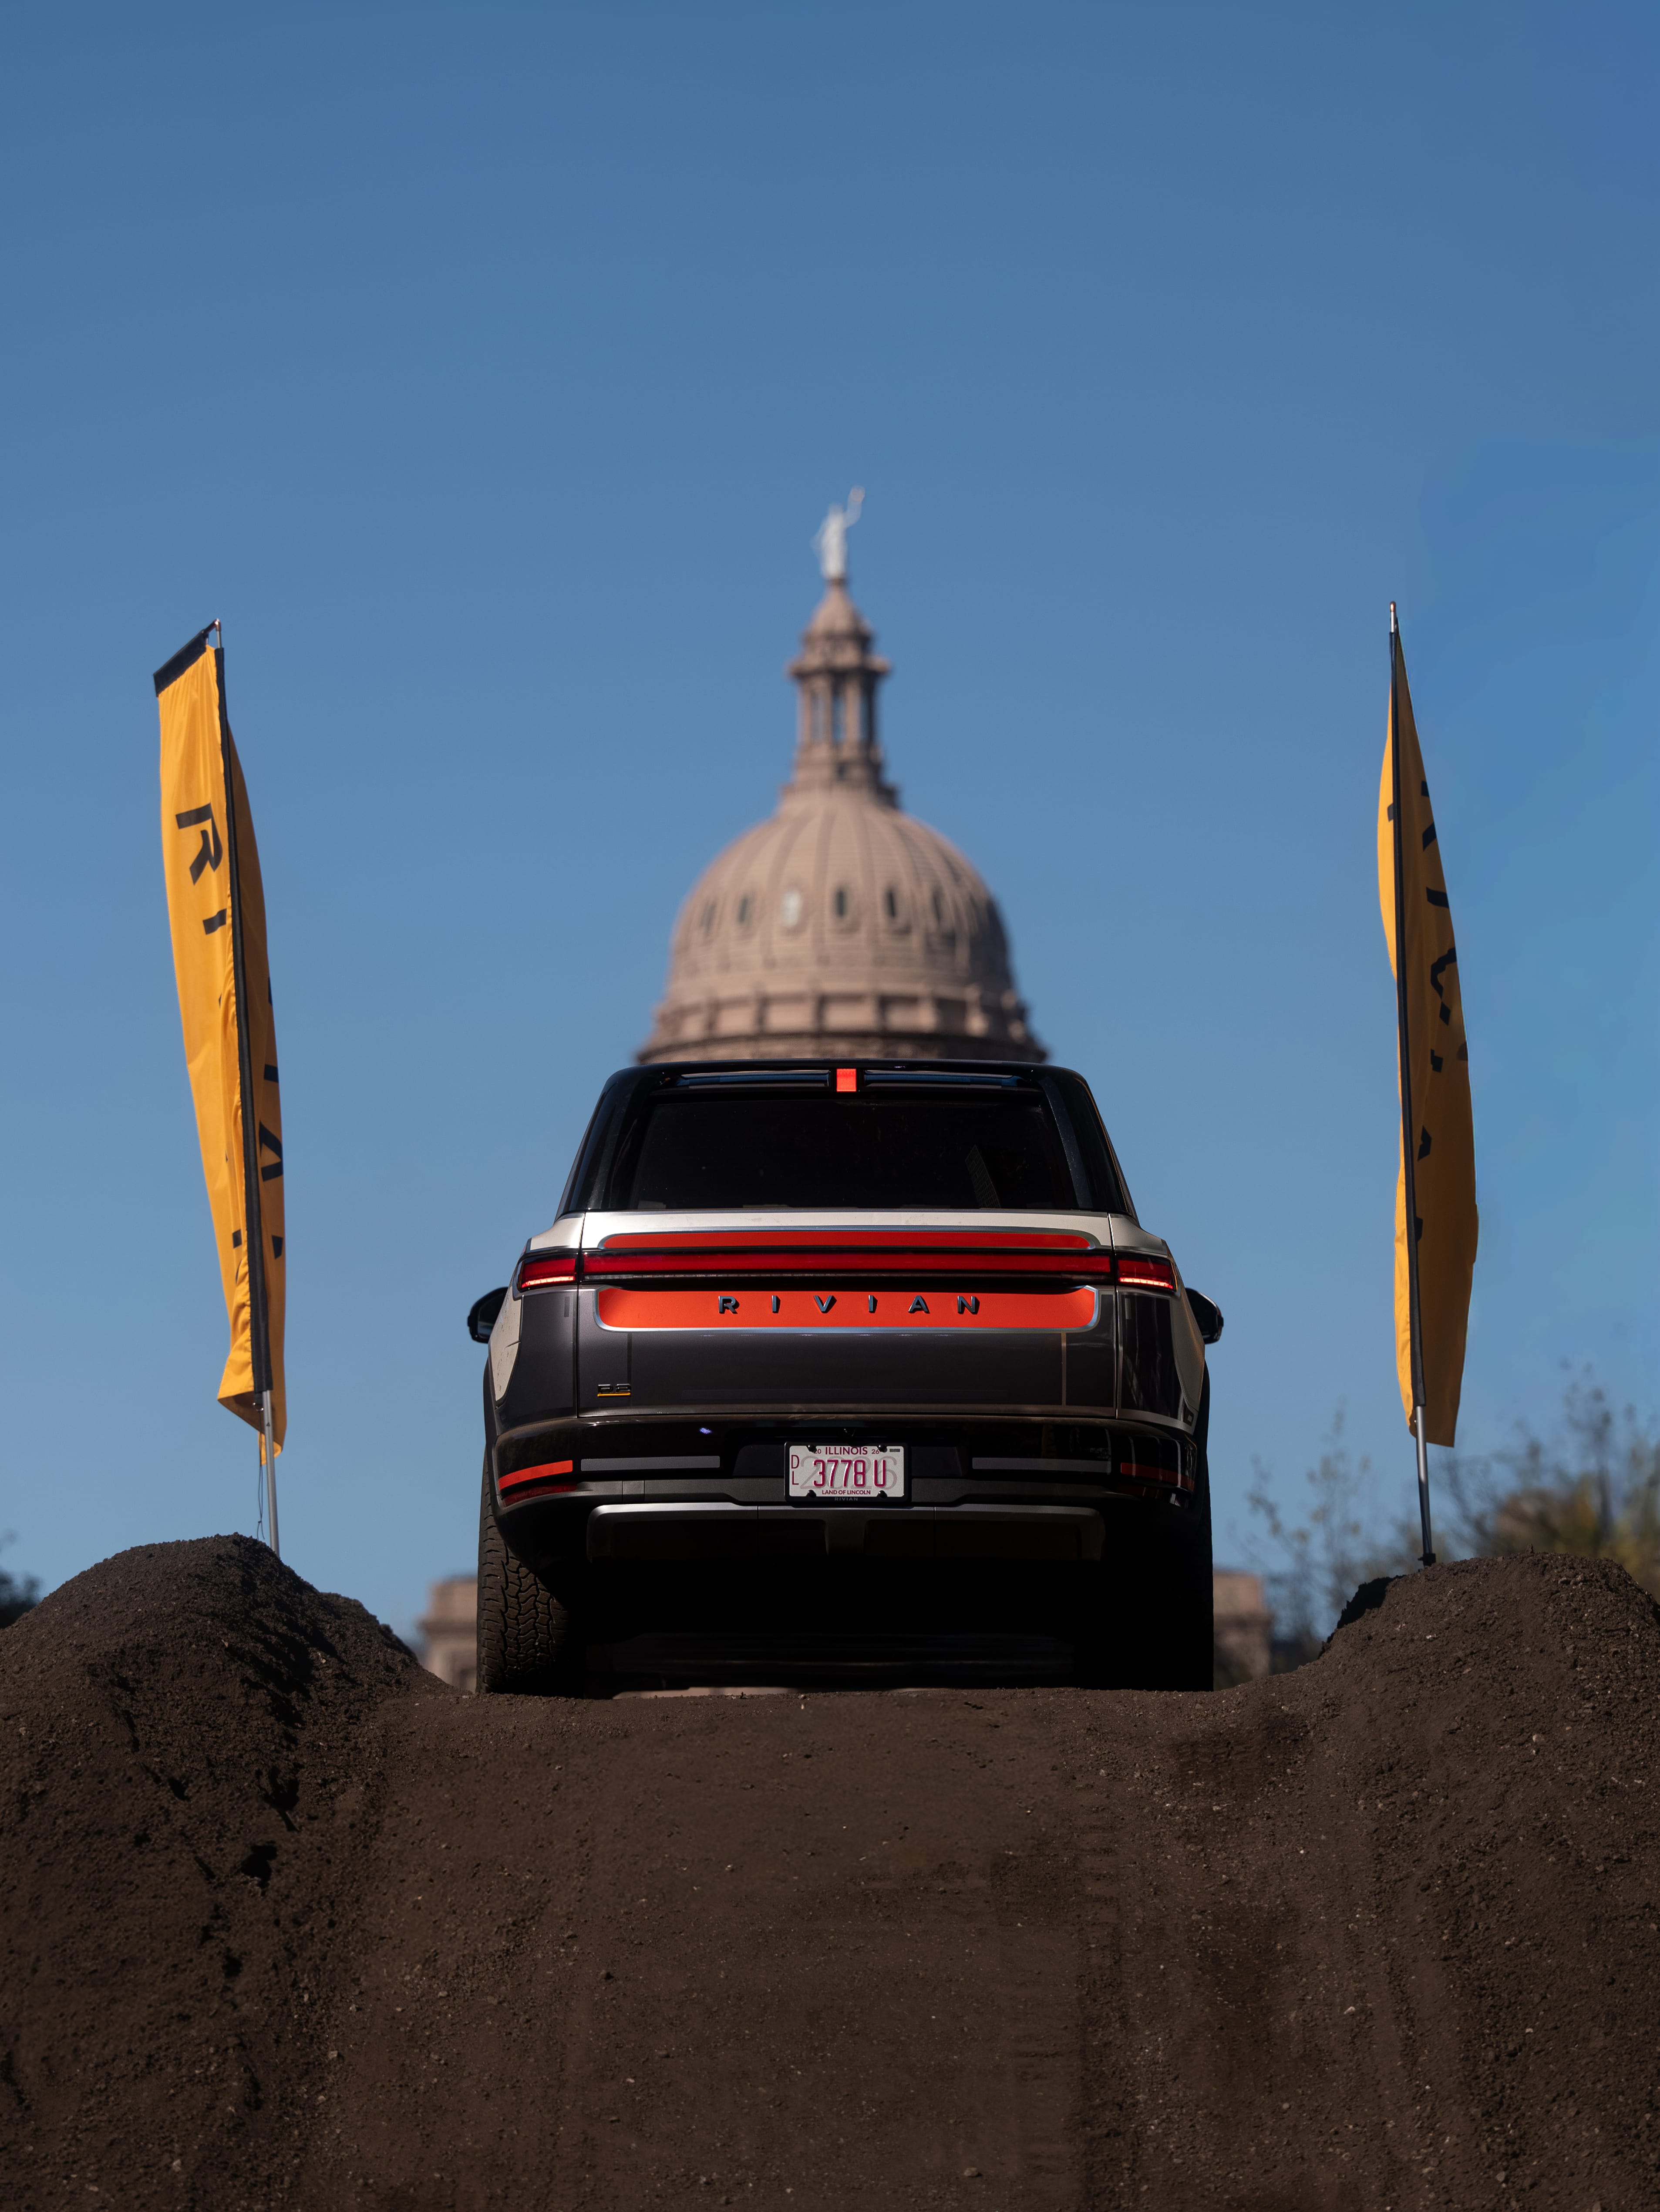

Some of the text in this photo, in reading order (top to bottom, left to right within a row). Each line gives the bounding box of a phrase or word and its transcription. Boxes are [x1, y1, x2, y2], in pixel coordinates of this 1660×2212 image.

[718, 1294, 979, 1314] RIVIAN
[825, 1446, 868, 1455] ILLINOIS
[813, 1459, 886, 1487] 3778 U
